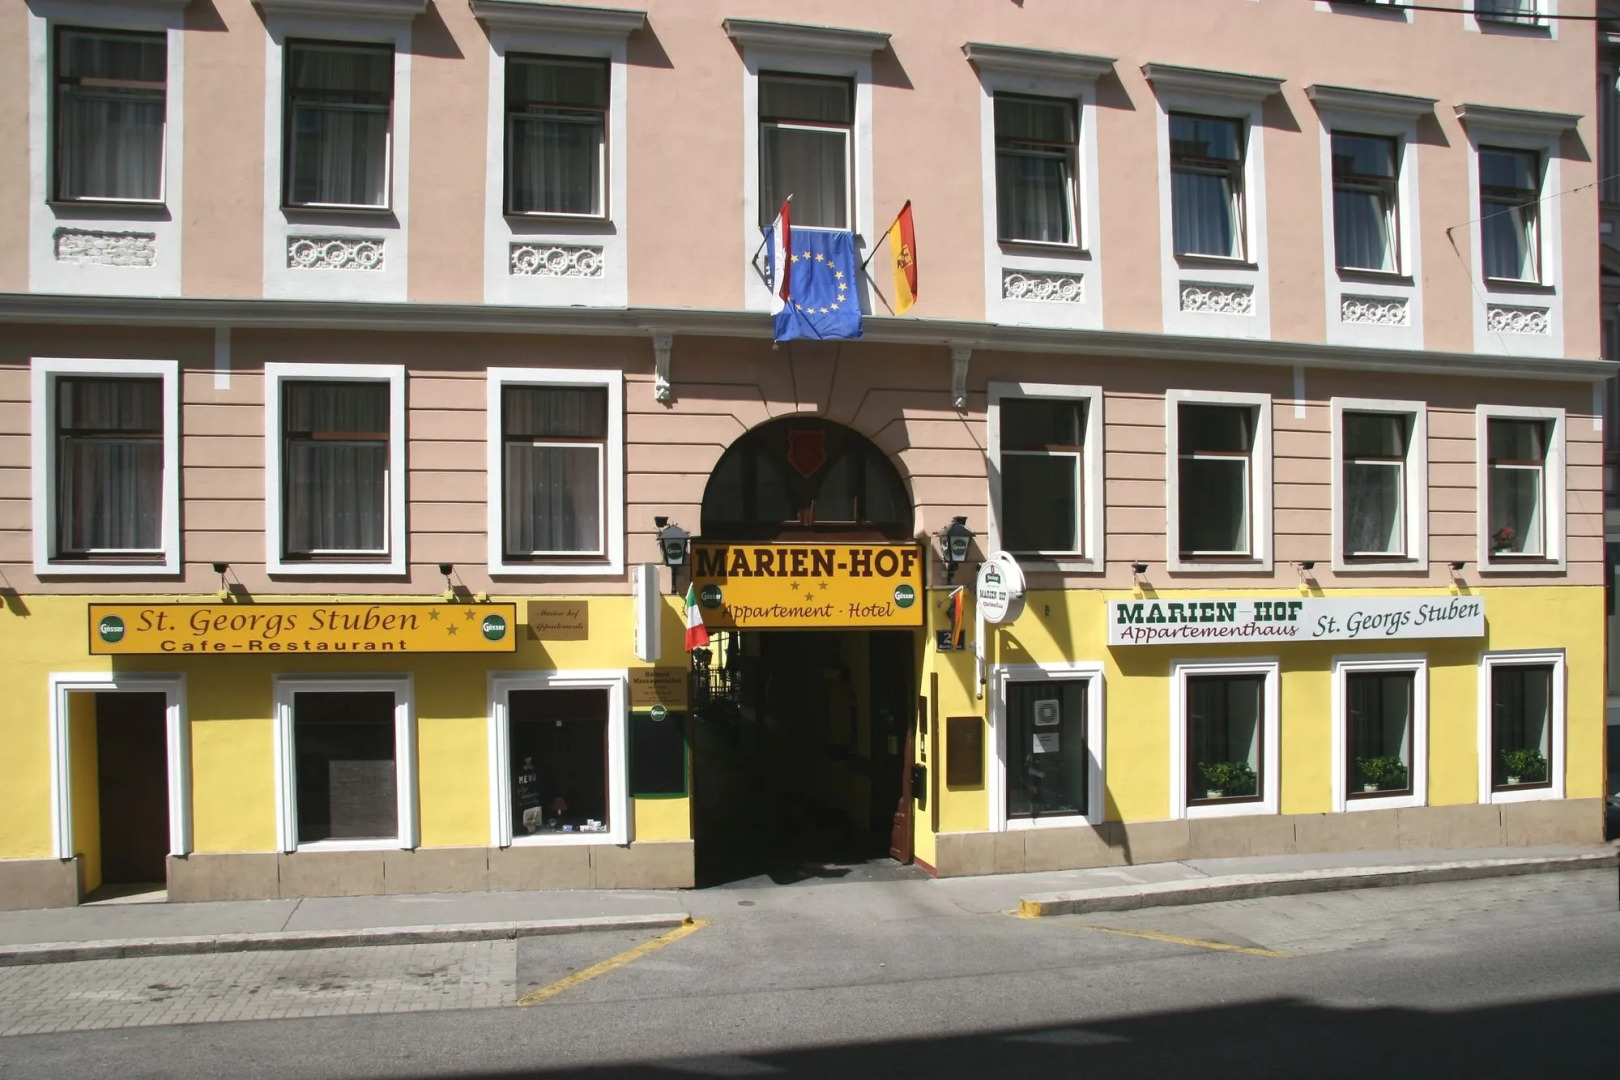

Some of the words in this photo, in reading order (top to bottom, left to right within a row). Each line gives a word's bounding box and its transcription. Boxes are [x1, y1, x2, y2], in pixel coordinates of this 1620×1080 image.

[696, 549, 917, 577] MARIEN-HOF
[137, 609, 175, 631] St.
[189, 609, 297, 639] Georgs
[309, 606, 419, 630] Stuben
[722, 604, 834, 623] Appartement
[848, 601, 894, 618] Hotel
[1312, 615, 1341, 637] St.
[1346, 609, 1411, 638] Georgs
[1413, 597, 1480, 626] Stuben
[100, 624, 123, 633] Gösser
[483, 622, 505, 632] Gösser
[1120, 621, 1300, 644] Appartementhaus
[160, 640, 407, 651] Cafe-Restaurant
